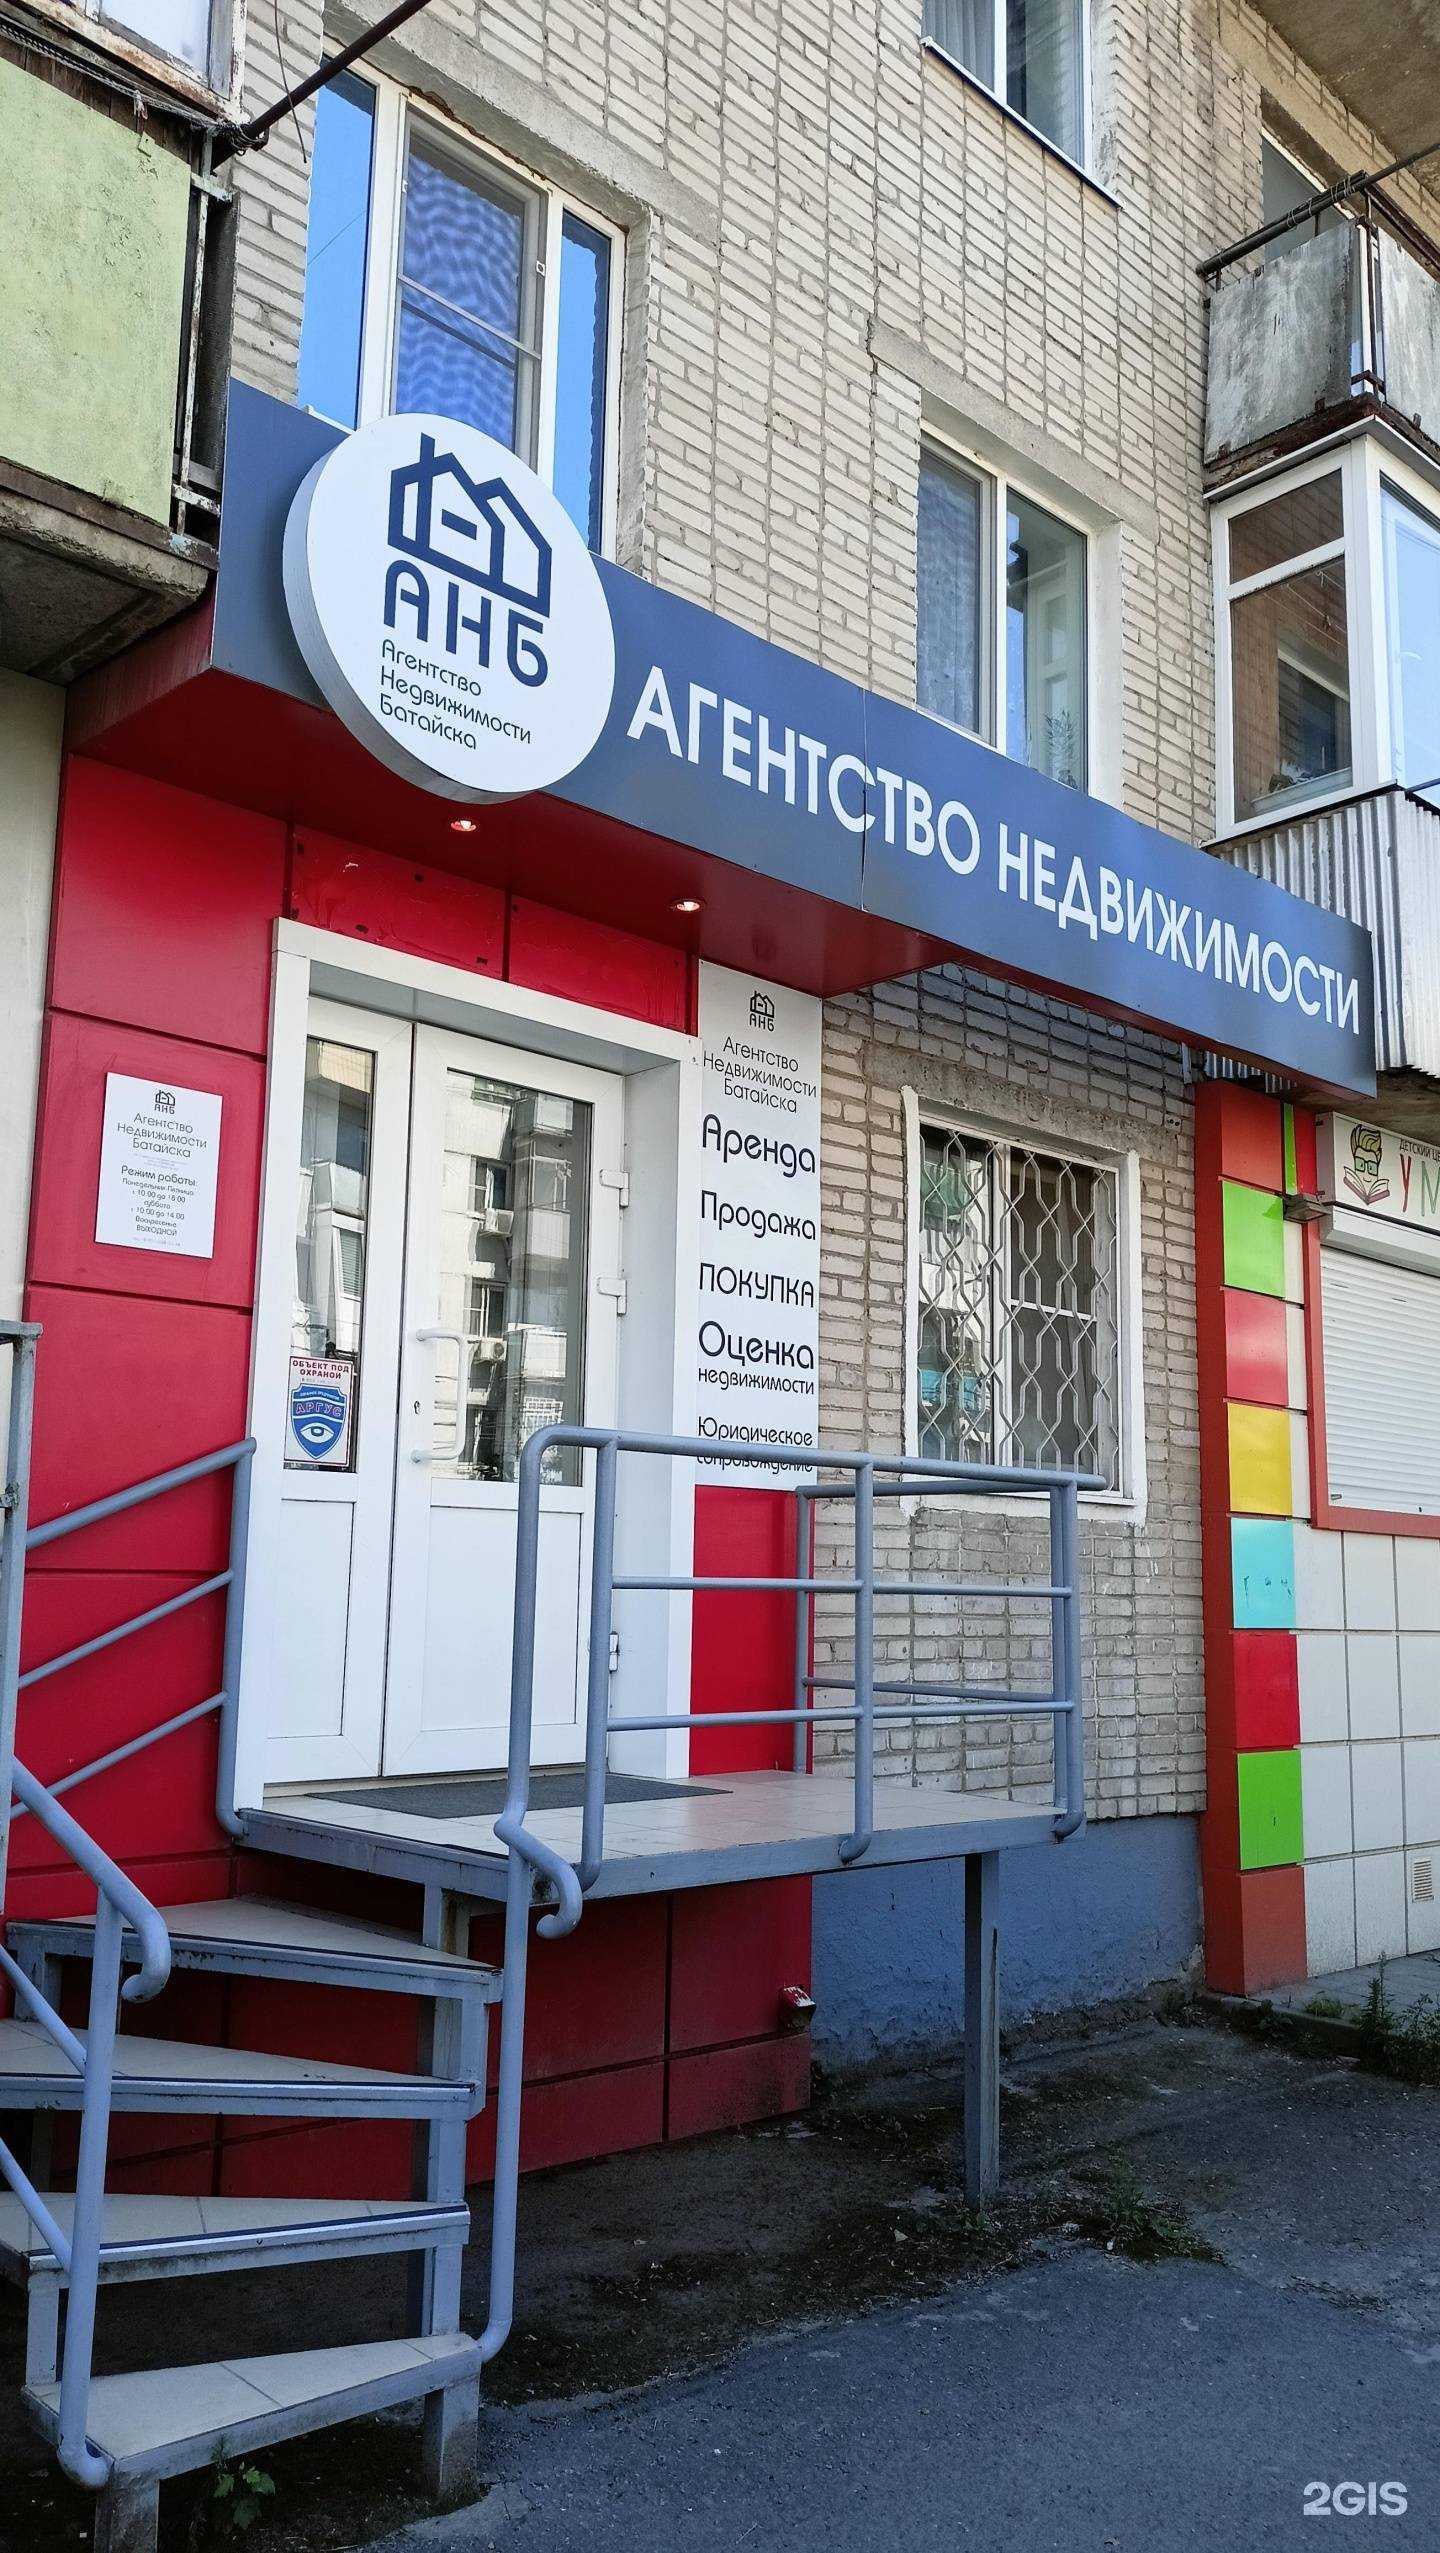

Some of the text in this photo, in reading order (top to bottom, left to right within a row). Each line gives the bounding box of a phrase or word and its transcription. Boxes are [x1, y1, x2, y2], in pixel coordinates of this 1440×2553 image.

[383, 559, 549, 688] АНБ
[381, 638, 482, 696] Агентство
[379, 693, 477, 750] Батайска
[380, 665, 532, 744] Недвижимости
[627, 665, 1360, 1035] АГЕНТСТВО НЕДВИЖИМОСТИ
[749, 1014, 775, 1032] АНБ
[723, 1036, 799, 1072] Агентство
[703, 1050, 817, 1098] Недвижимости
[724, 1078, 797, 1113] Батайска
[117, 1123, 207, 1148] Недвижимости
[133, 1112, 193, 1133] Агентство
[132, 1138, 191, 1158] Батайска
[702, 1113, 816, 1178] Аренда
[121, 1165, 156, 1180] Режим
[701, 1189, 816, 1241] Продажа
[699, 1262, 814, 1308] ПОКУПКА
[699, 1320, 814, 1370] Оценка
[292, 1360, 350, 1373] ОБЪЕКТ ПОД
[698, 1367, 814, 1395] недвижимости
[295, 1402, 342, 1417] АРГУС
[698, 1416, 813, 1446] Юридическое
